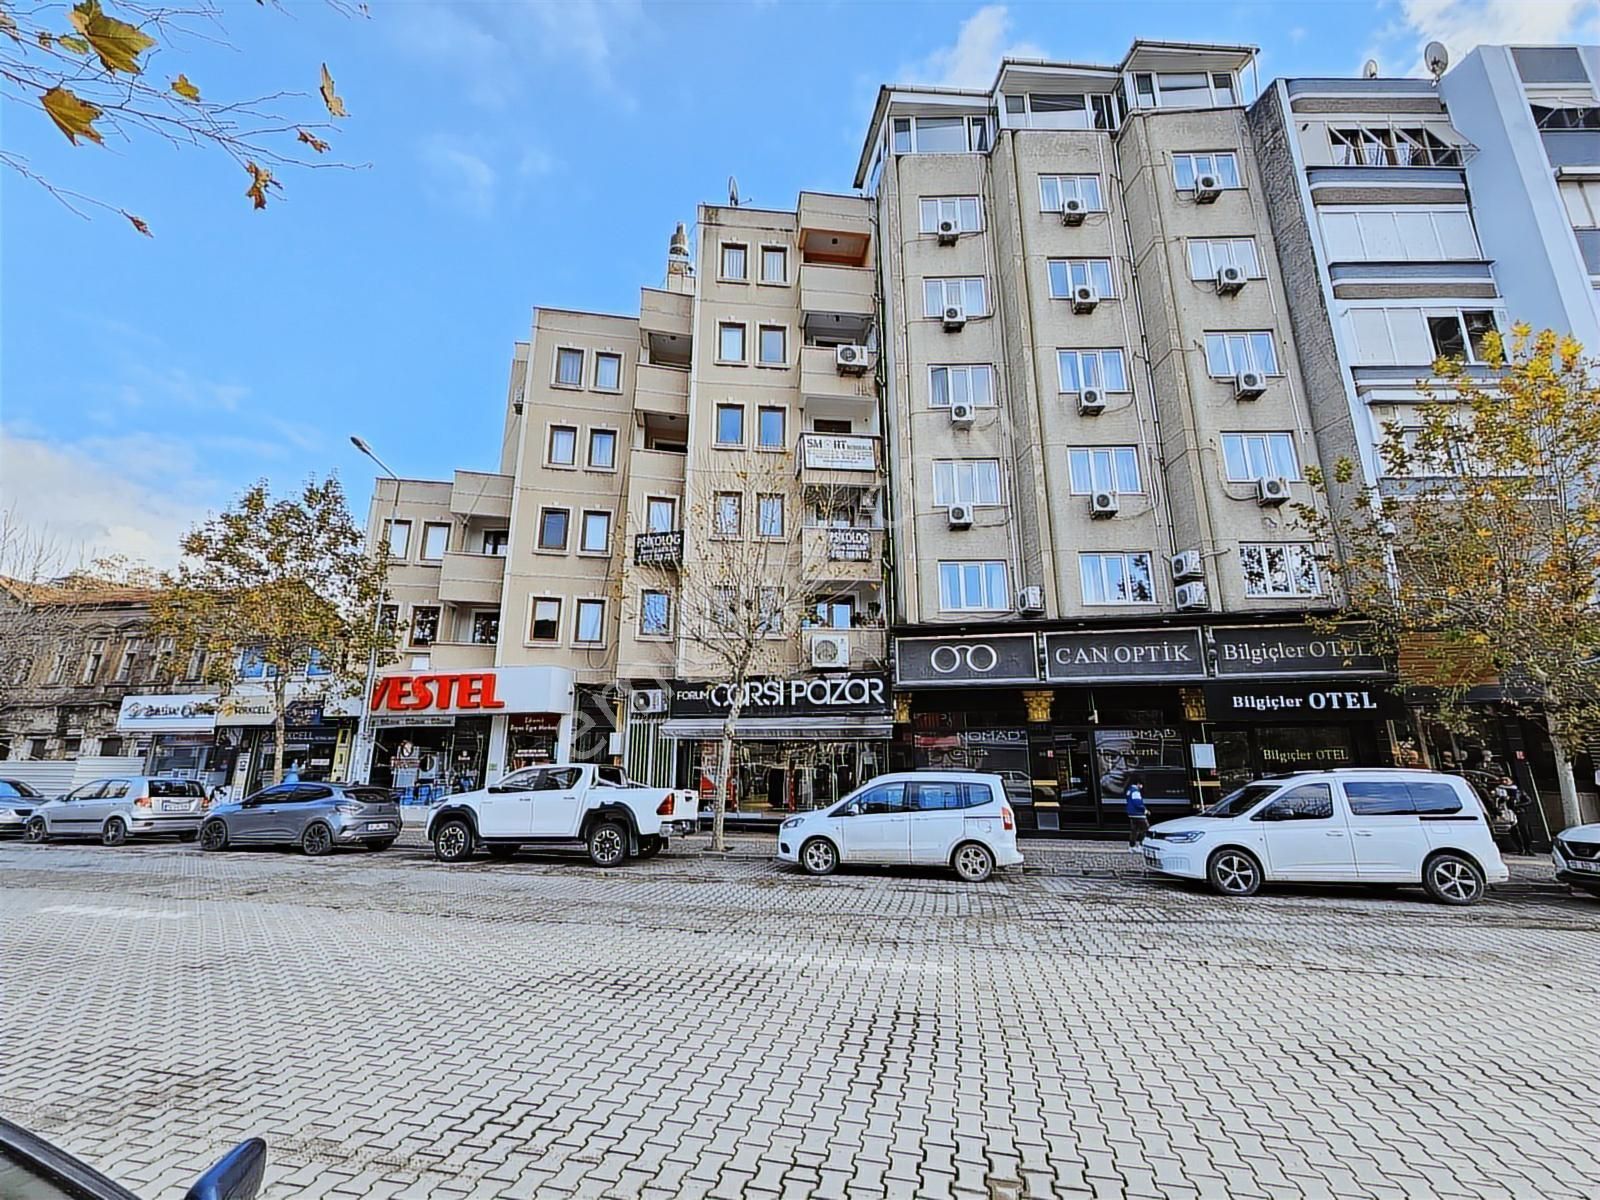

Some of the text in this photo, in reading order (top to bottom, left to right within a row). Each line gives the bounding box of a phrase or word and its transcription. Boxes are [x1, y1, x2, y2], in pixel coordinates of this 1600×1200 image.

[1055, 641, 1192, 664] CAN OPTİK
[1223, 642, 1305, 664] Bilgiçler
[1232, 691, 1378, 711] Bilgiçler OTEL
[956, 731, 1021, 743] NOMAD
[1316, 749, 1349, 760] OTEL
